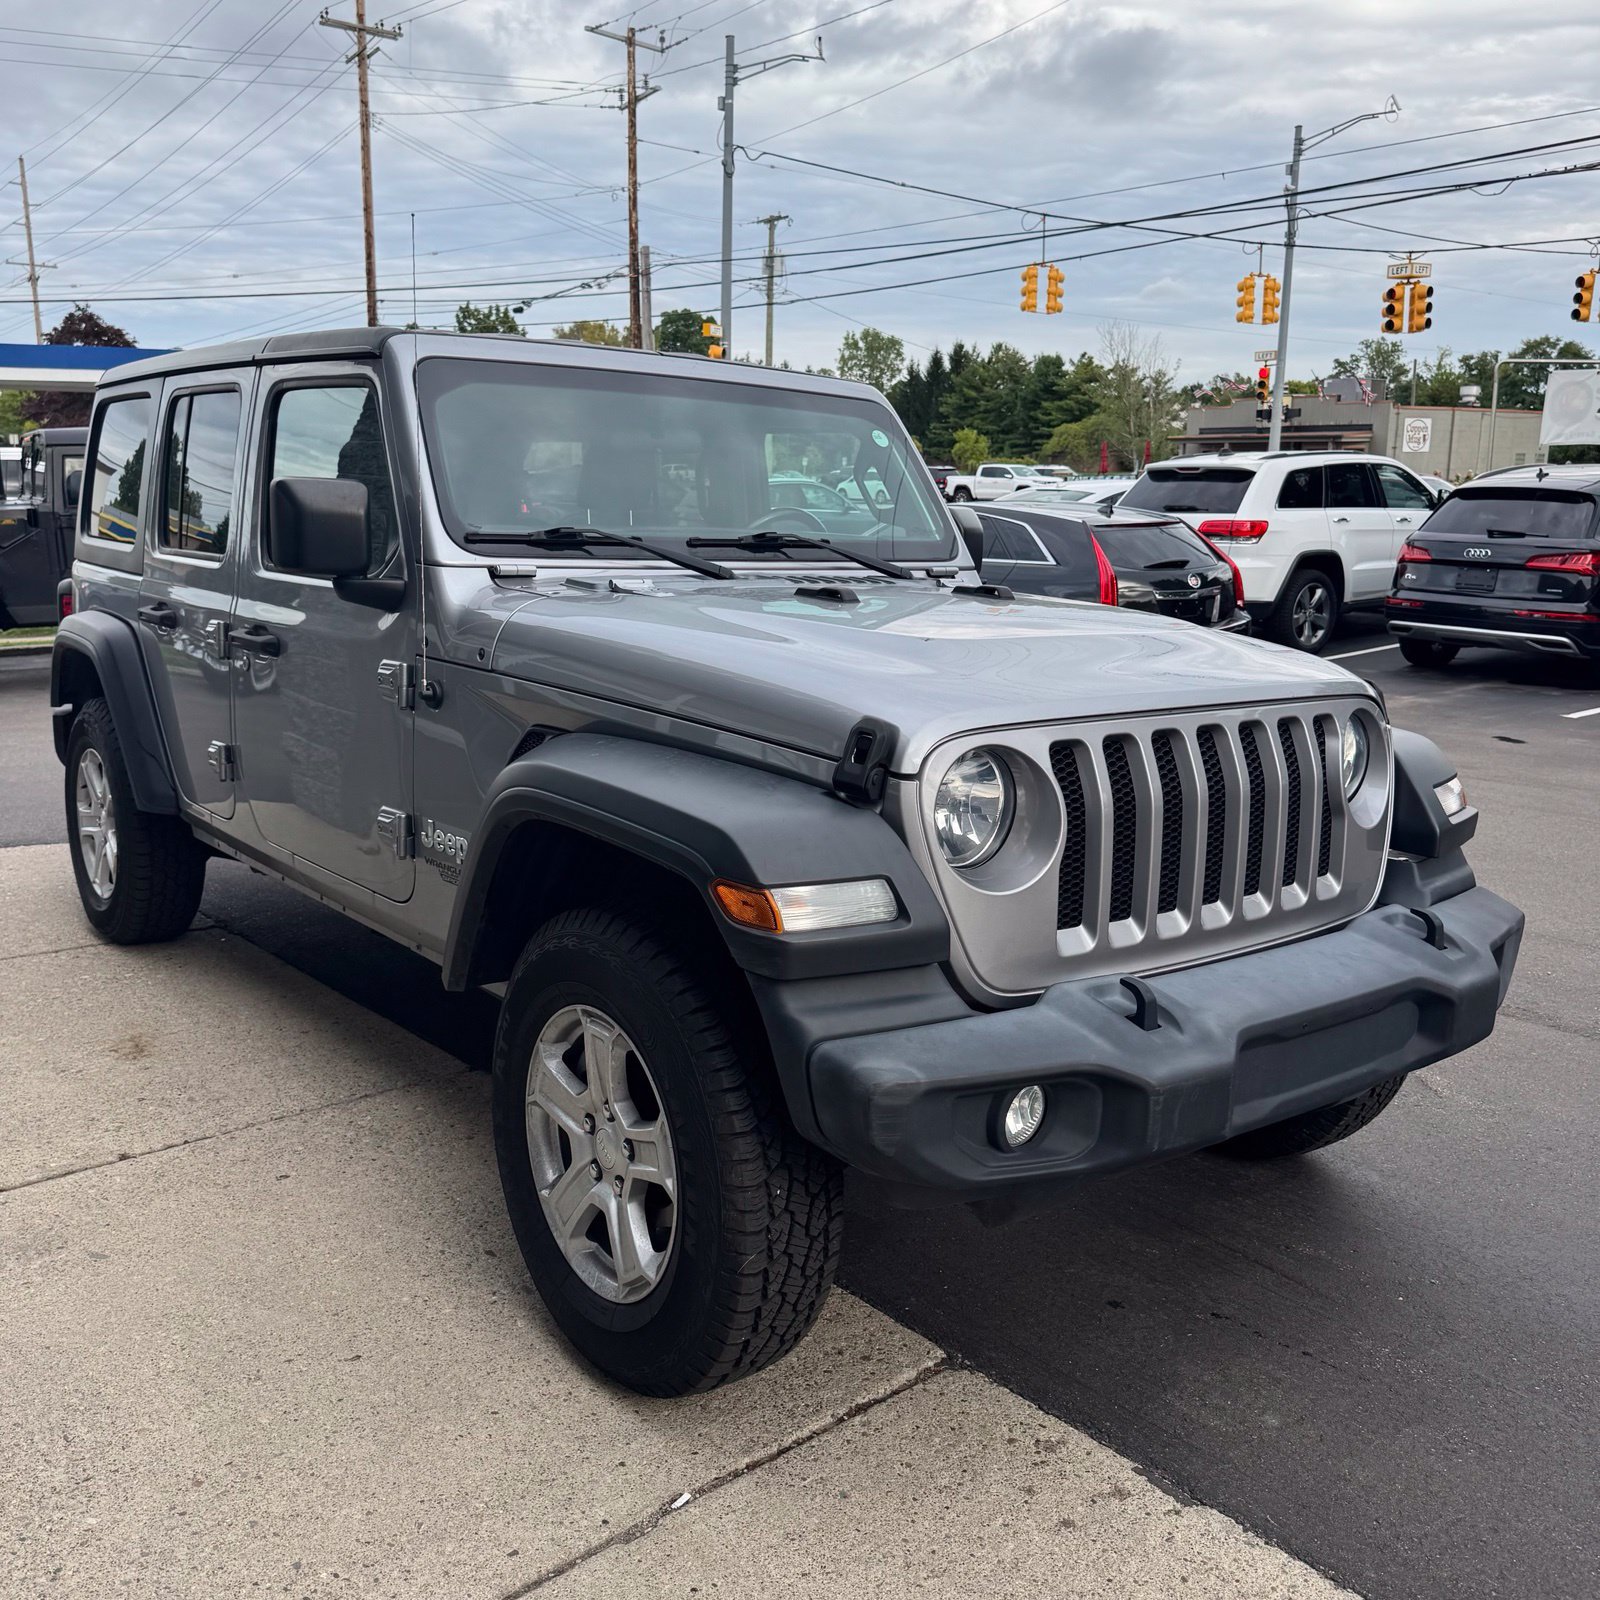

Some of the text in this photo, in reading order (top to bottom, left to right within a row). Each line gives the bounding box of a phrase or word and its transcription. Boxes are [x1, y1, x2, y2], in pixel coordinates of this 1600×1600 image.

[1391, 265, 1408, 275] LEFT
[1415, 265, 1429, 274] LEFT
[421, 819, 468, 864] Jeep
